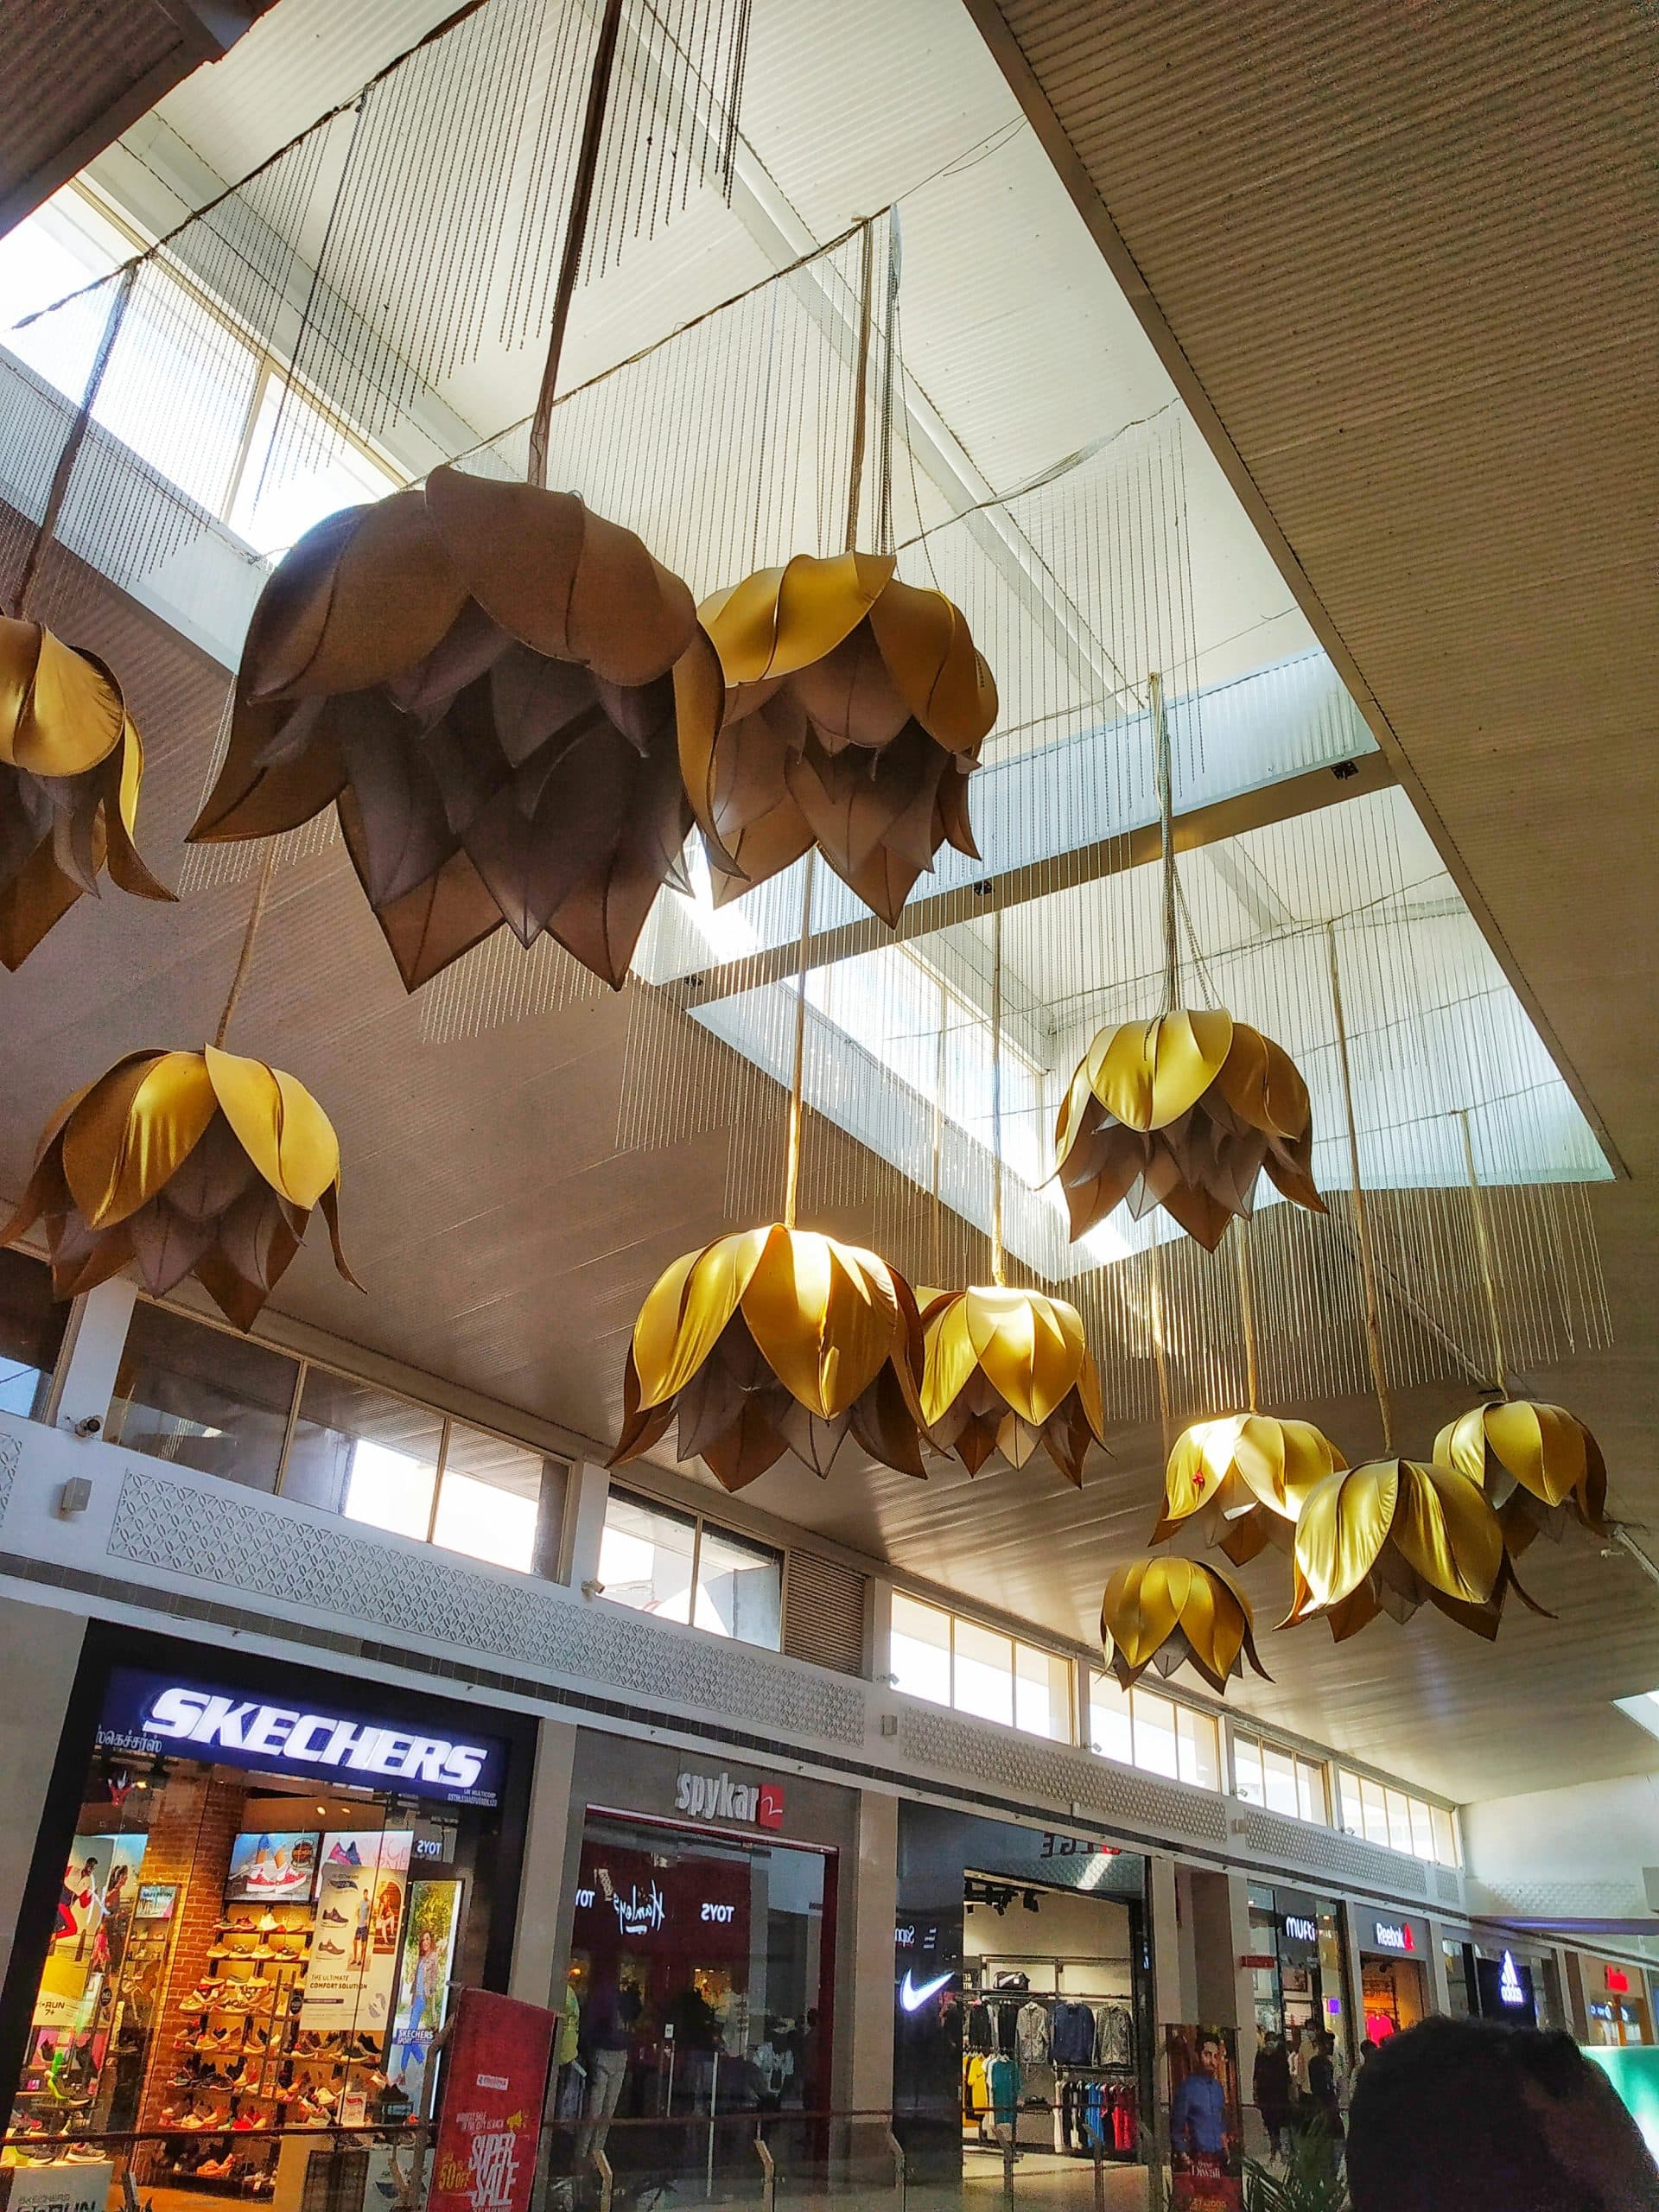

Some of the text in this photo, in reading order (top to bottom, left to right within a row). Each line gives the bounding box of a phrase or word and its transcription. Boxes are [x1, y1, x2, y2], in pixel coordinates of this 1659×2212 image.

[142, 1688, 489, 1789] SKECHERS
[675, 1772, 760, 1822] spykar
[1376, 1922, 1406, 1949] Reebok
[398, 2030, 434, 2040] SKECHERS
[468, 2133, 516, 2171] SUPER
[1192, 2164, 1222, 2178] Diwali
[471, 2162, 519, 2206] SALE
